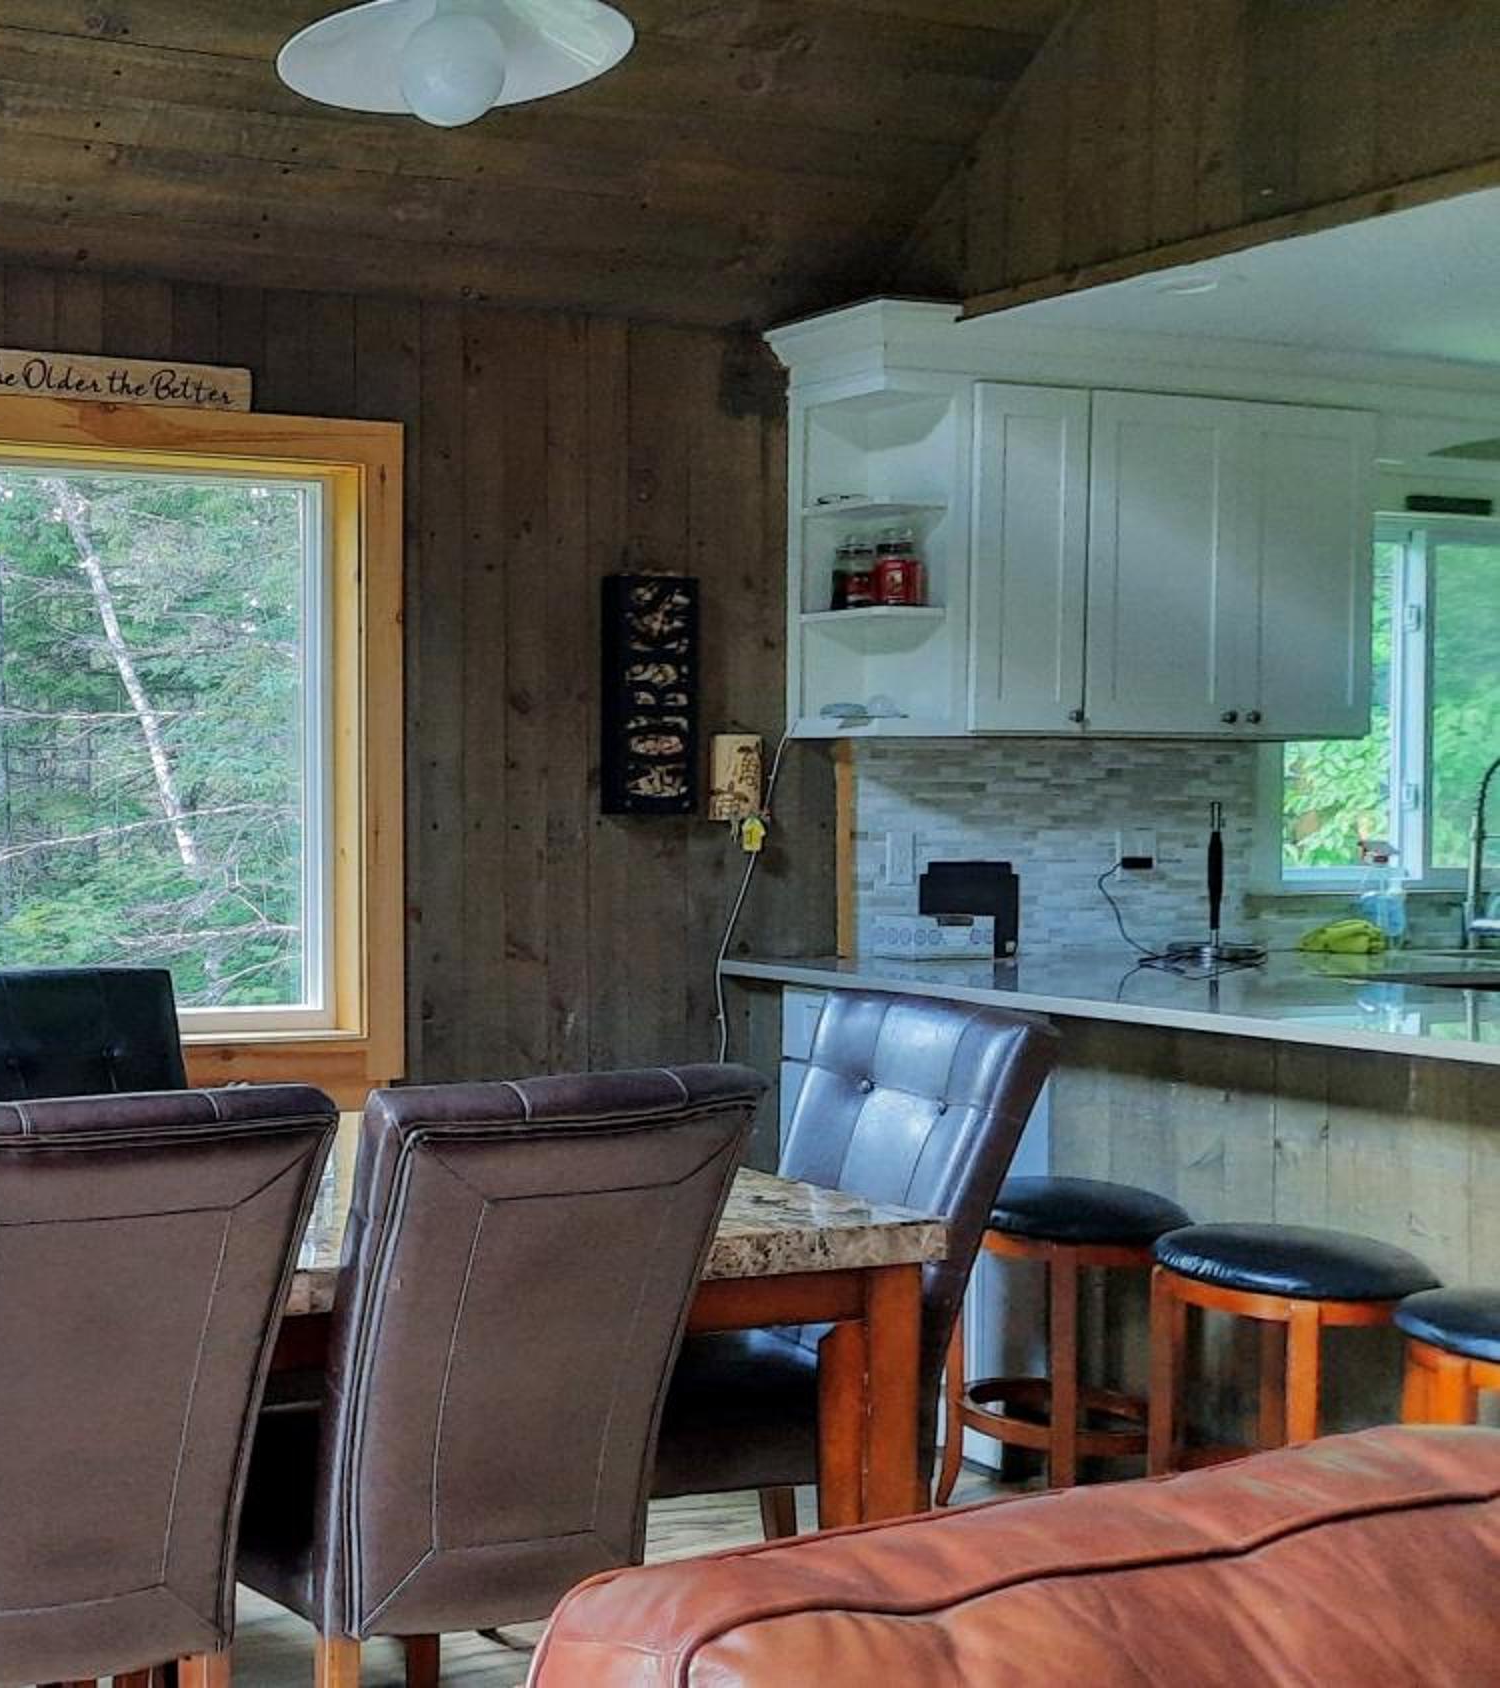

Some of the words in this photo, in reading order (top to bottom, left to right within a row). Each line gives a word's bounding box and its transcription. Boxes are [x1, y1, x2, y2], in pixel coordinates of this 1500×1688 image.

[22, 358, 100, 392] Older
[107, 369, 148, 397] the
[150, 369, 235, 404] Better
